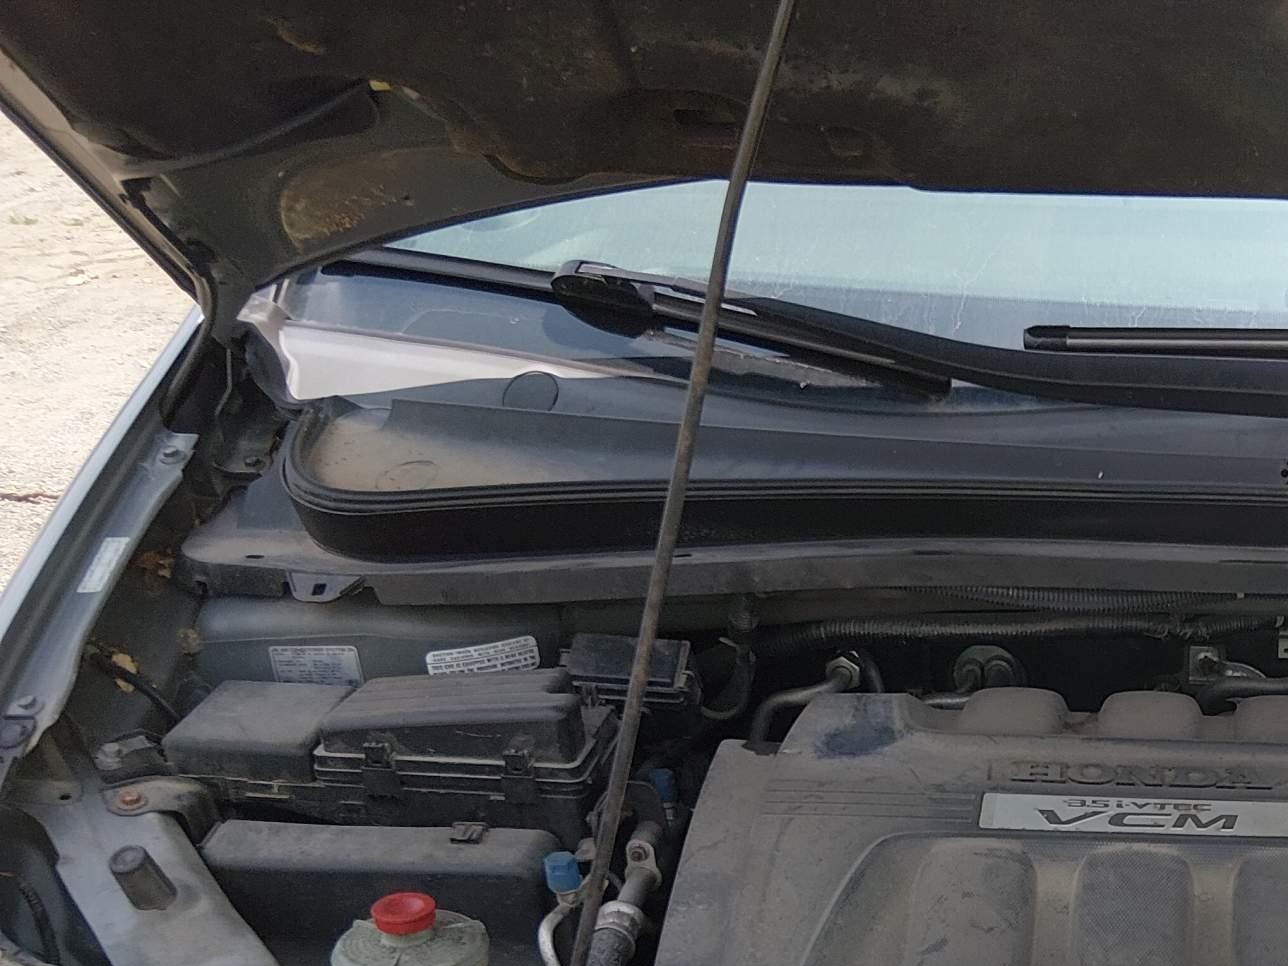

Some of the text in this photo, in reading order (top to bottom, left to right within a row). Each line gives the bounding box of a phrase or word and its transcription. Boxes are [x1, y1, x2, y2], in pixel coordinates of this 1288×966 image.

[1009, 761, 1273, 790] HONDA
[1117, 800, 1212, 811] i-VTEC
[1038, 809, 1239, 832] VCM
